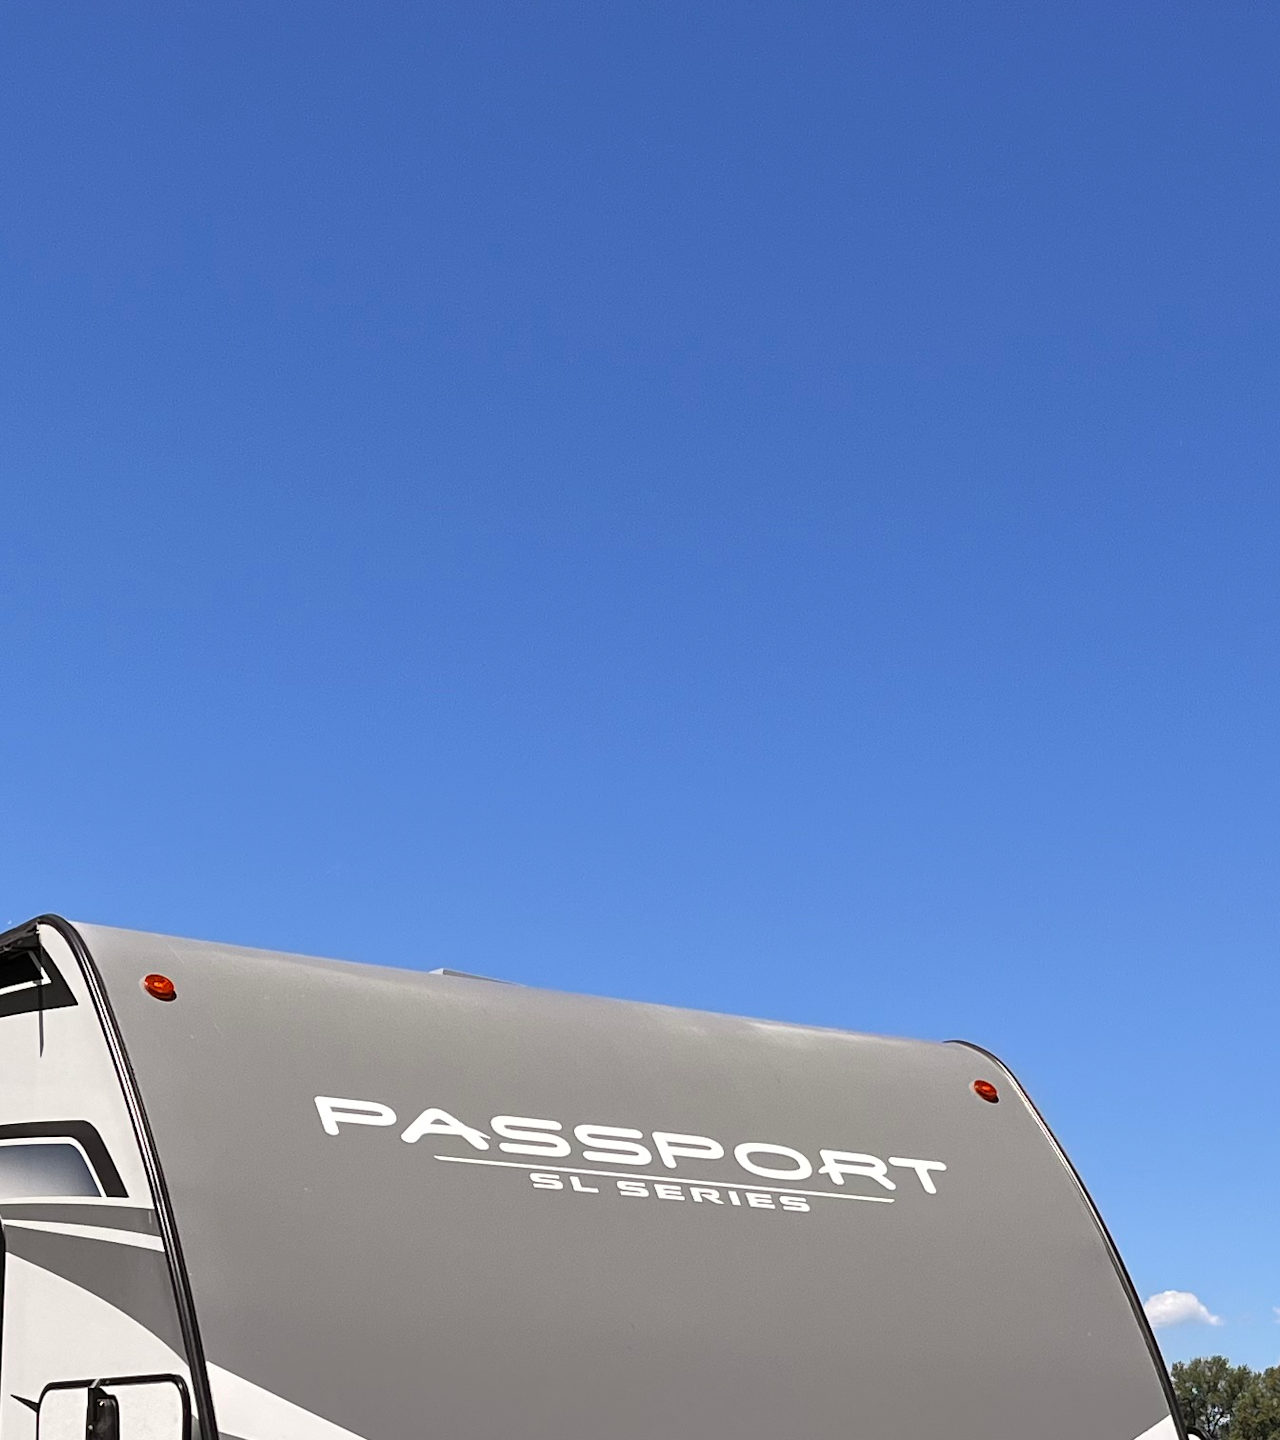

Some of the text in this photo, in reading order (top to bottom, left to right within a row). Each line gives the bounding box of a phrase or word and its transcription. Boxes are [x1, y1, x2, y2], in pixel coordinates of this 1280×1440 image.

[314, 1096, 947, 1194] PASSPORT
[529, 1172, 811, 1213] SL SERIES
